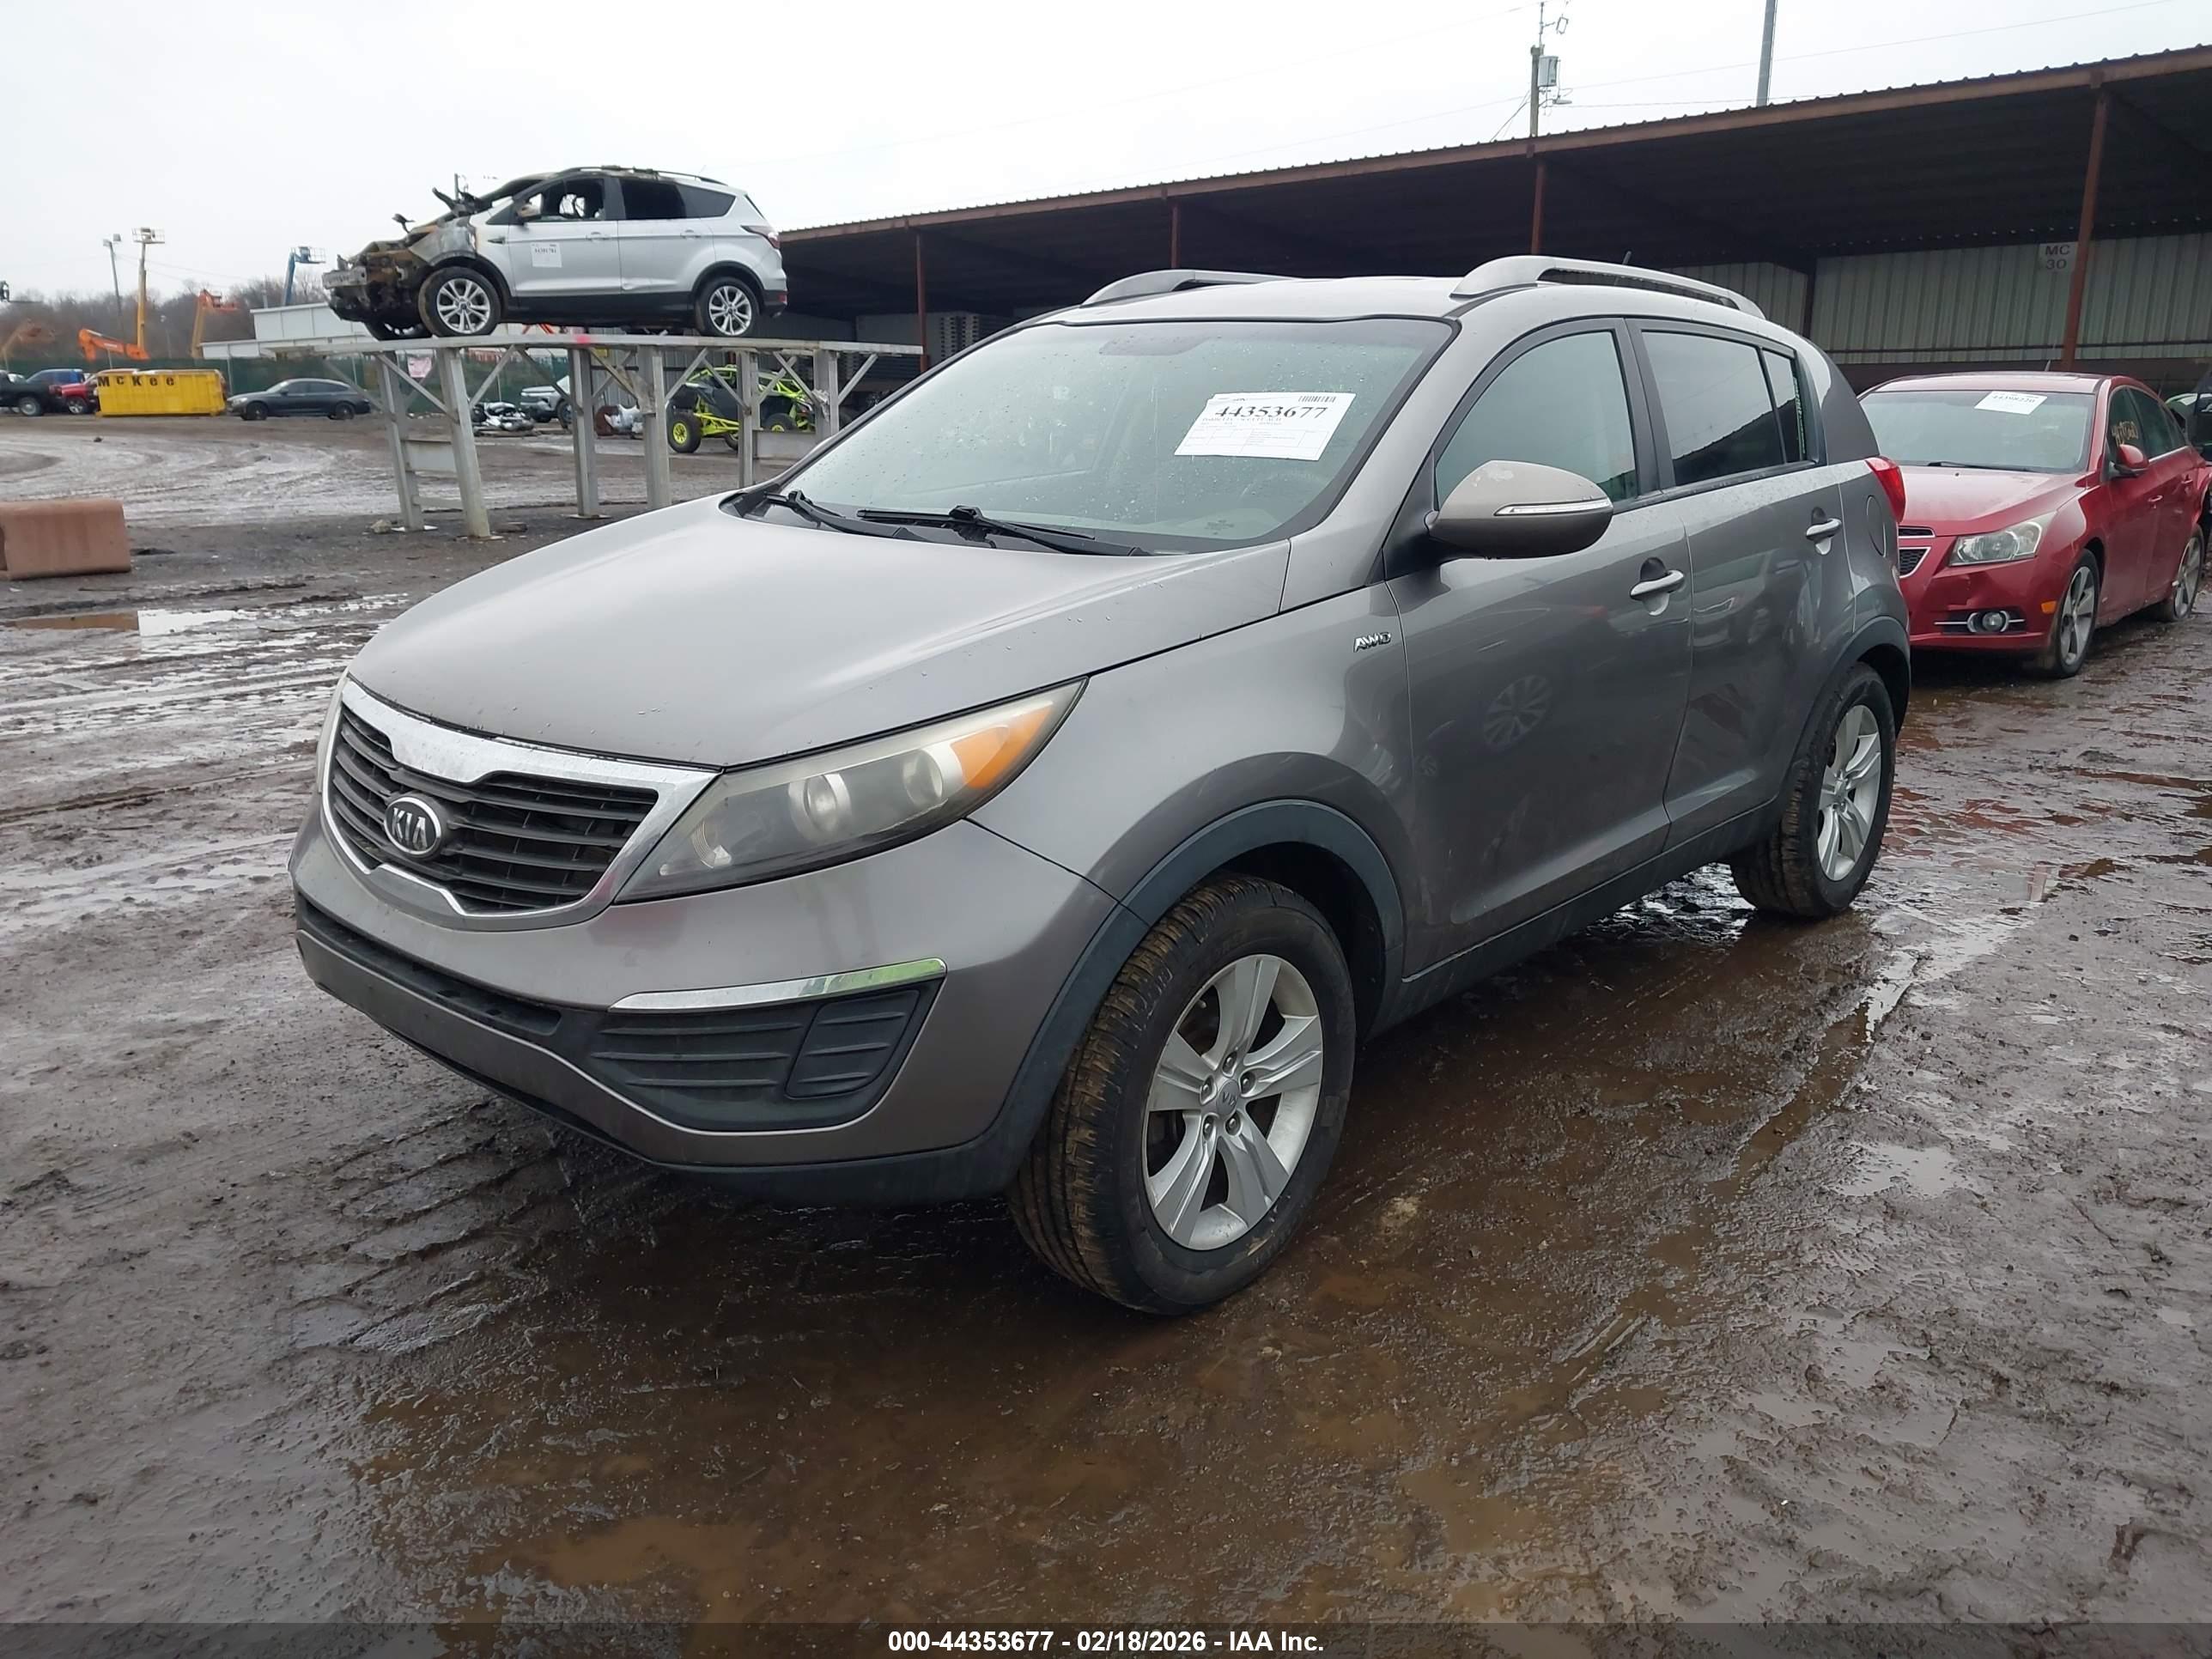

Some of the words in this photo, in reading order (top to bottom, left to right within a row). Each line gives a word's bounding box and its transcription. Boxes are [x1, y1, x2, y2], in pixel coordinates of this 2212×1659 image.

[2045, 244, 2070, 255] MC
[2046, 258, 2067, 270] 30
[1215, 405, 1329, 419] 44353677
[1353, 632, 1391, 653] AWD
[392, 807, 428, 850] KIA
